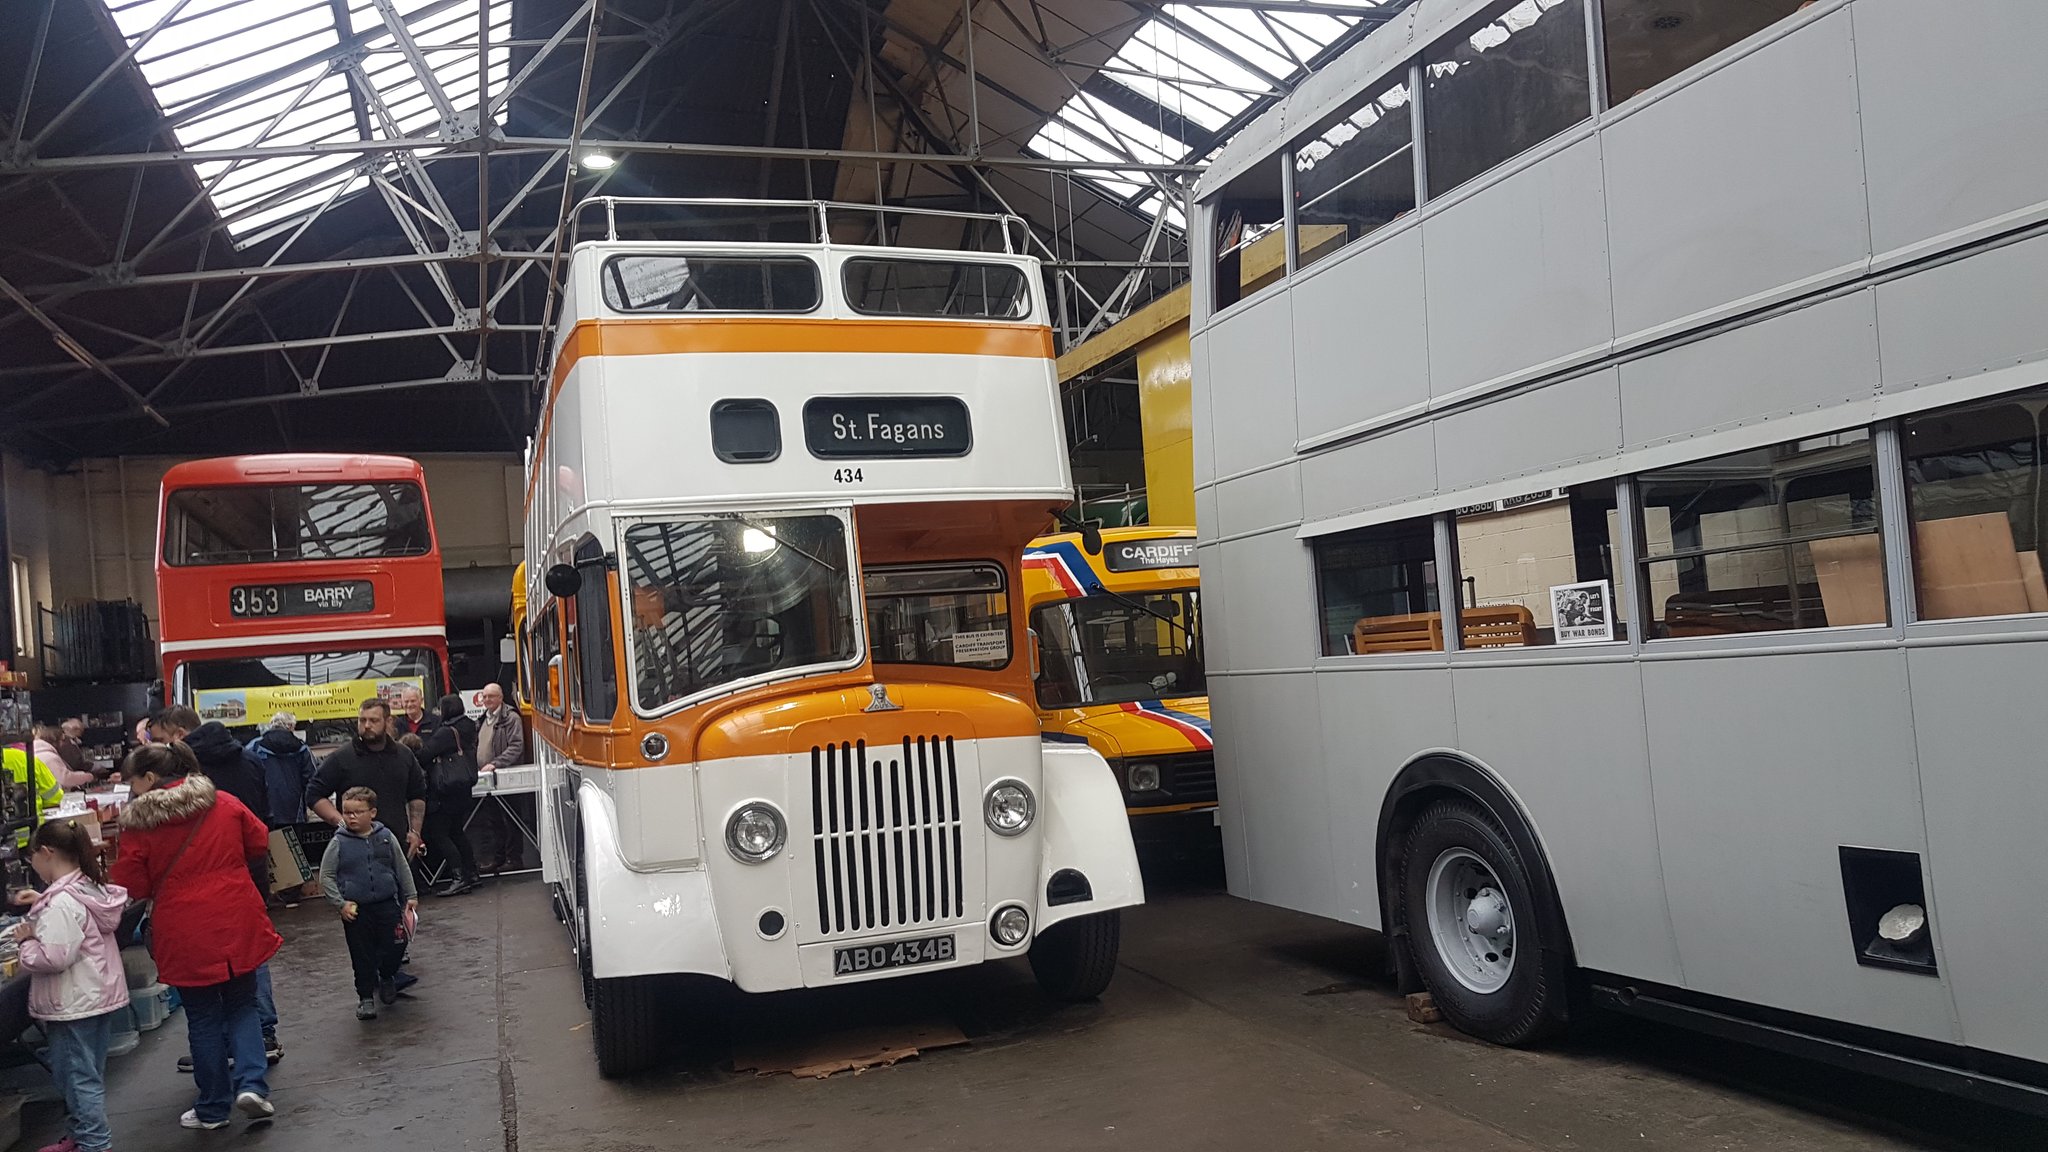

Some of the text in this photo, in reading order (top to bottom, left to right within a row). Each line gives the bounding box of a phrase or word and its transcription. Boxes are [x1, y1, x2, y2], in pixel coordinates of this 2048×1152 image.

[832, 413, 945, 443] St. Fagans
[833, 468, 864, 483] 434
[1121, 544, 1193, 558] CARDIFF
[1156, 556, 1179, 565] Hayes
[233, 588, 279, 613] 353
[304, 586, 354, 602] BARRY
[331, 599, 343, 608] Ely
[1572, 629, 1585, 637] WAR
[1587, 628, 1605, 636] BONDS
[272, 686, 350, 698] Cardiff Transport
[268, 696, 355, 709] Preservation Group
[838, 938, 953, 973] ABO 434B
